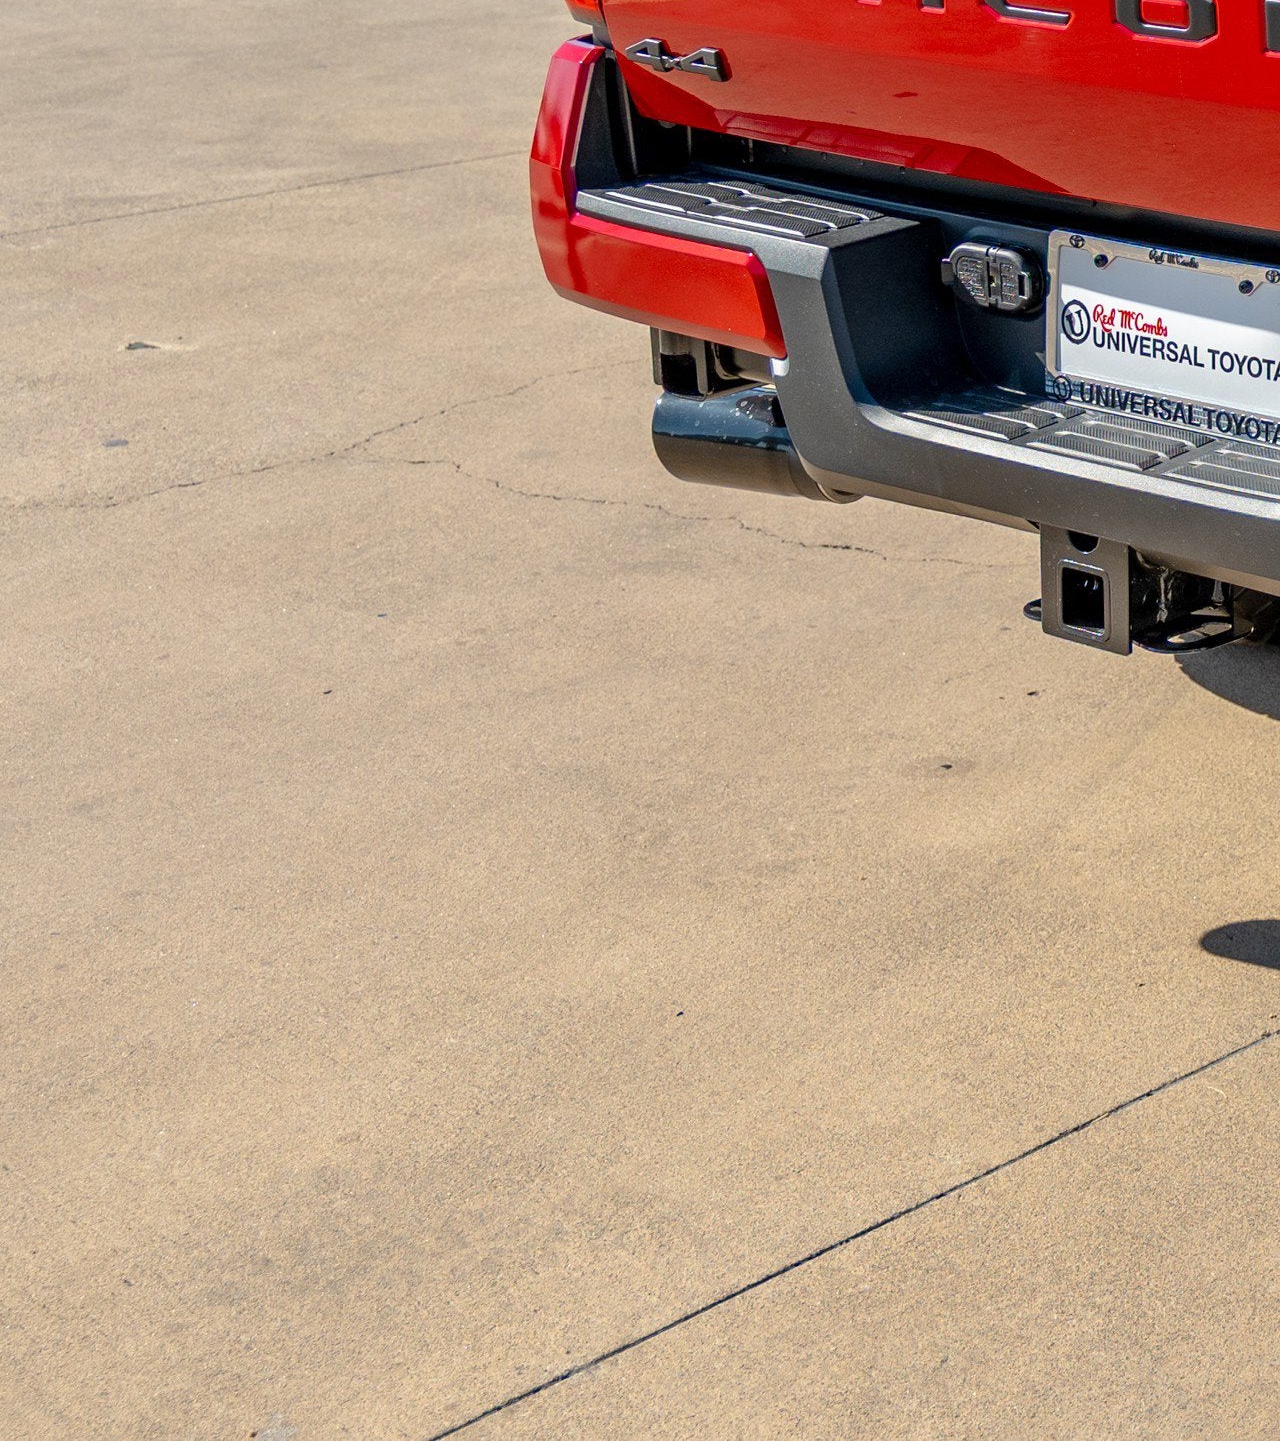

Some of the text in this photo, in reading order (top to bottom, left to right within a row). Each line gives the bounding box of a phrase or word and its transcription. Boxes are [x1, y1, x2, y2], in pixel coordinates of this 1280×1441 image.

[1093, 304, 1168, 337] Red McCombs
[1092, 326, 1205, 368] UNIVERSAL
[1080, 380, 1202, 425] UNIVERSAL
